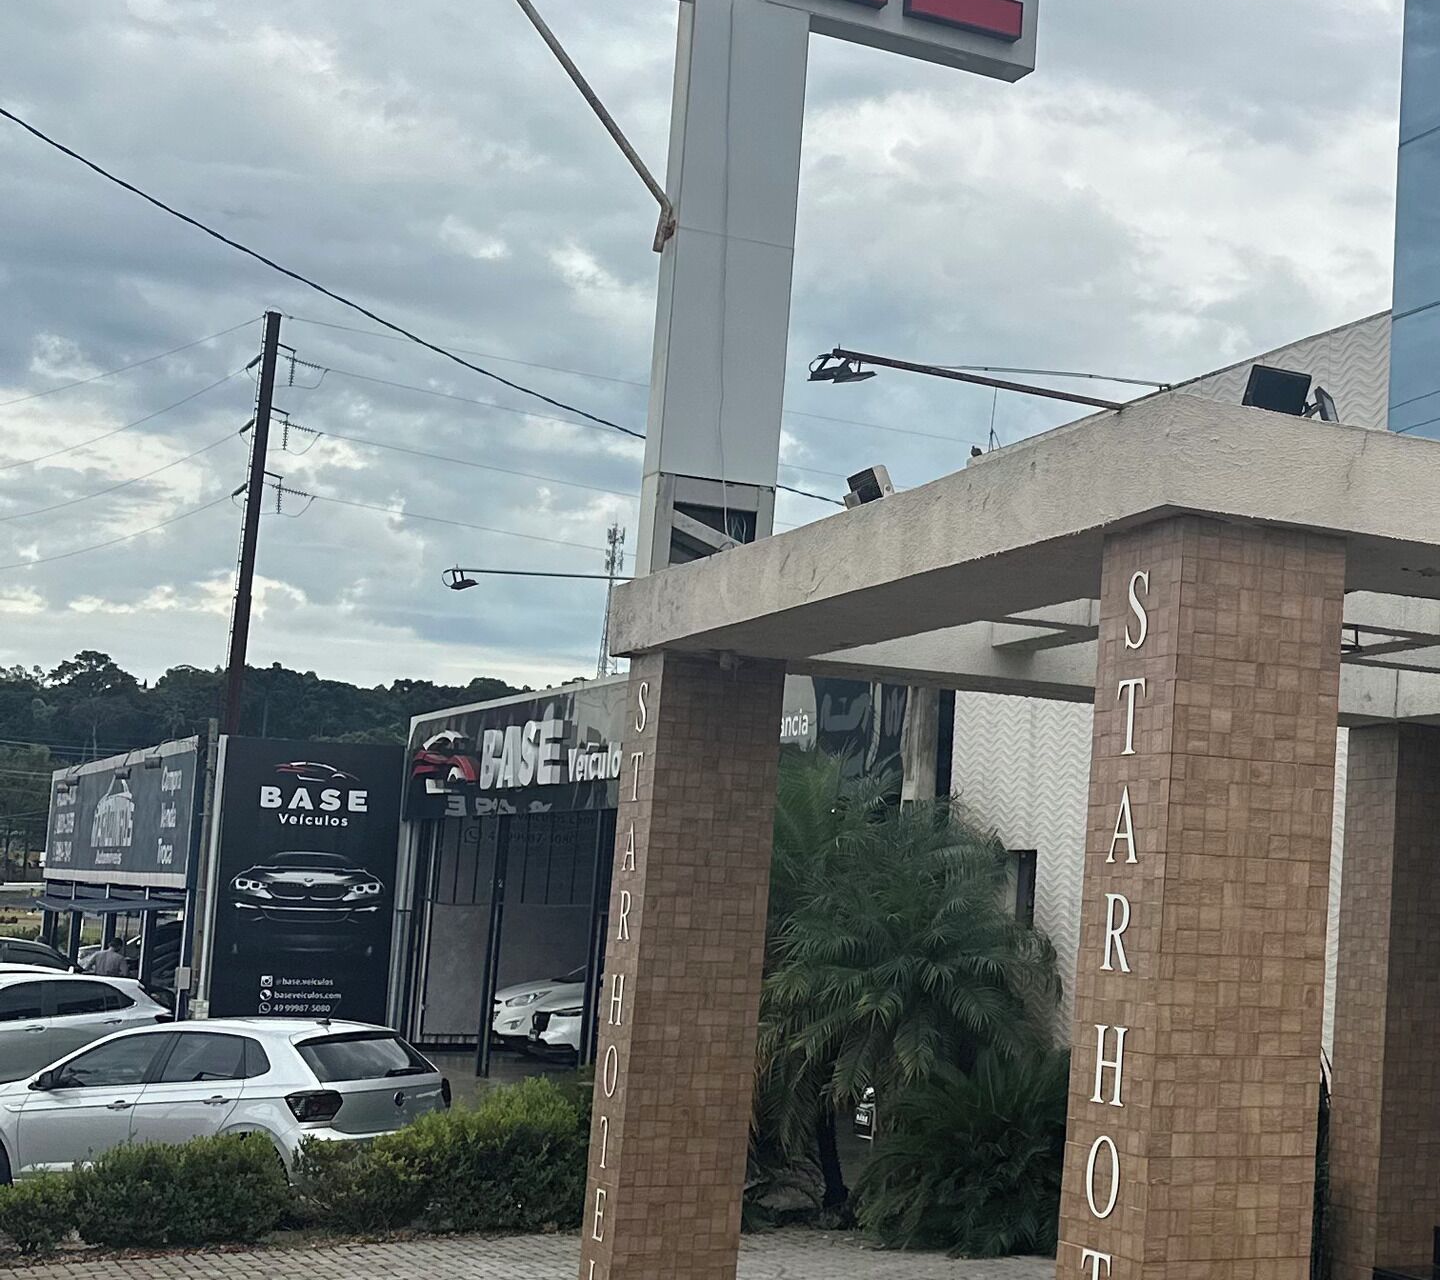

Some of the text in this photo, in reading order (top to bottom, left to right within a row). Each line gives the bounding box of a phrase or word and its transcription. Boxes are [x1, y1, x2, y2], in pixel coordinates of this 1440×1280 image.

[479, 718, 623, 791] BASE Veículo
[1099, 569, 1149, 974] STAR
[260, 785, 368, 812] BASE
[278, 813, 349, 827] Veículos
[615, 681, 650, 941] STAR
